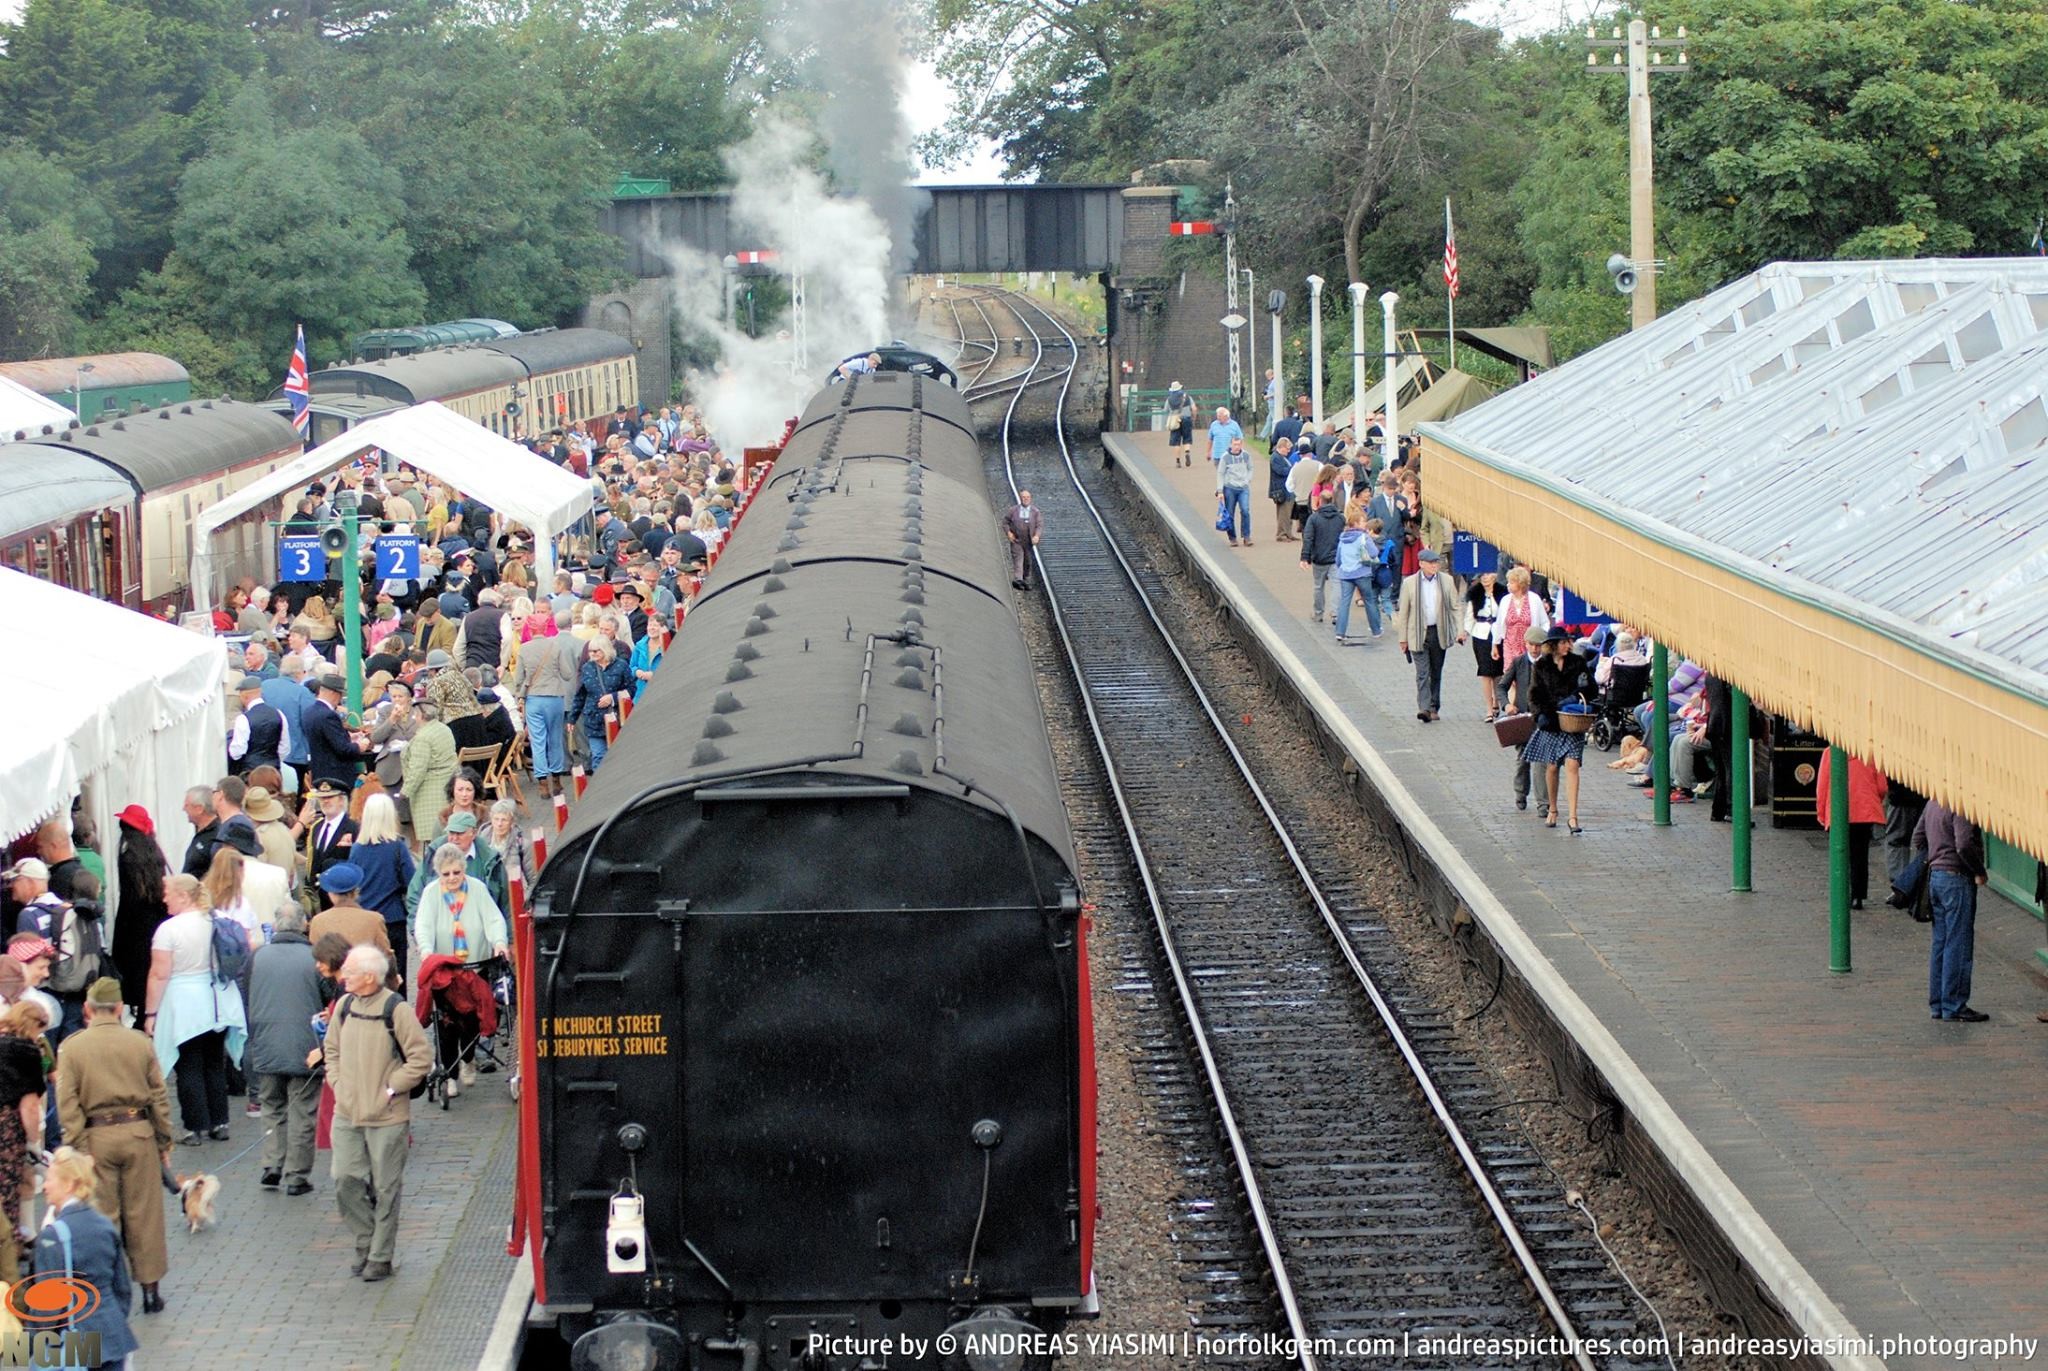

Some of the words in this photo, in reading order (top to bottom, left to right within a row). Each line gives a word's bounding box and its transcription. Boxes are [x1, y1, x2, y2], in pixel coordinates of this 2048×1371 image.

[380, 539, 416, 547] PLATFORM
[295, 549, 311, 575] 3
[390, 547, 407, 574] 2
[542, 1016, 612, 1036] FNCHURCH
[617, 1015, 661, 1034] STREET
[624, 1036, 667, 1055] SERVICE
